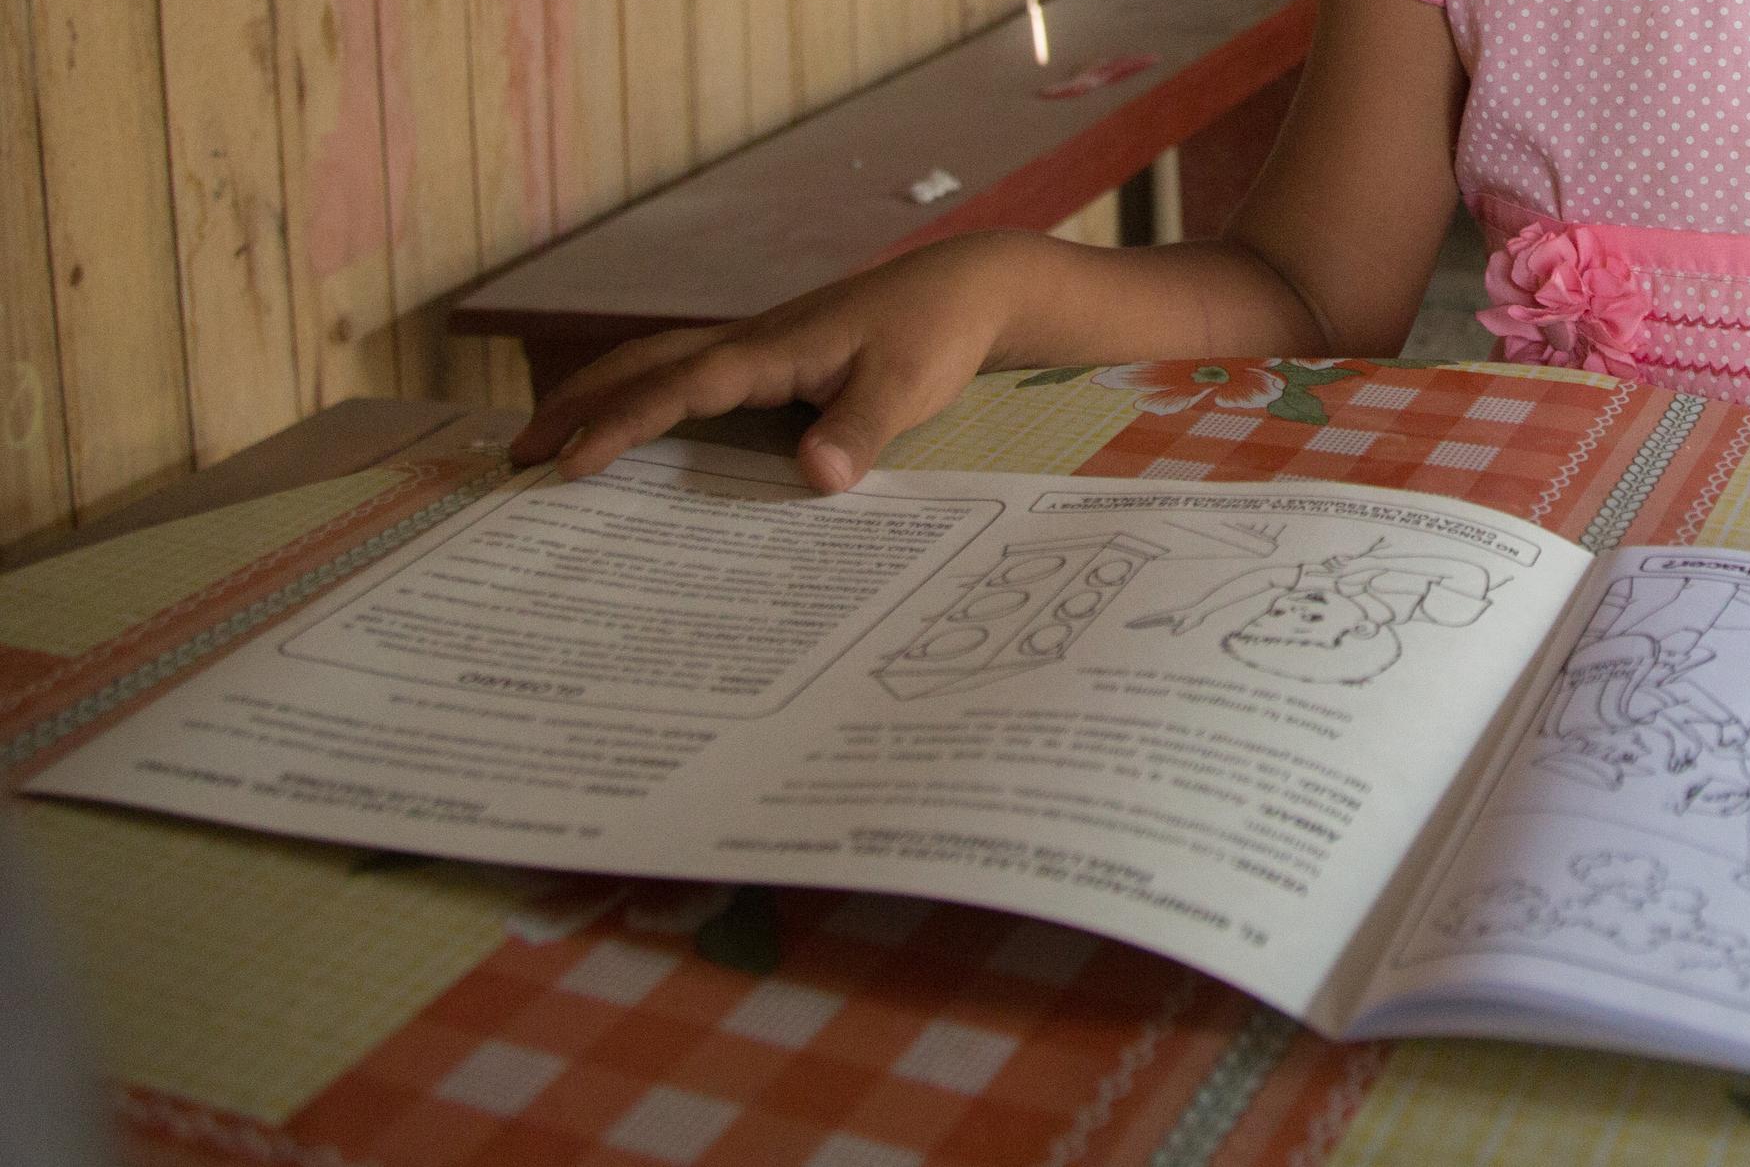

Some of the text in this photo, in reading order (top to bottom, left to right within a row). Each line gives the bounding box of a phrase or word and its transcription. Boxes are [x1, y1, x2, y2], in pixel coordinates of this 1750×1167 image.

[1334, 508, 1397, 522] RIESGO
[1371, 505, 1405, 518] LAS
[1404, 512, 1442, 525] POR
[1398, 517, 1422, 527] EN
[1424, 523, 1495, 547] PONGAS
[1441, 520, 1499, 541] CRUZA
[1494, 544, 1522, 558] NO
